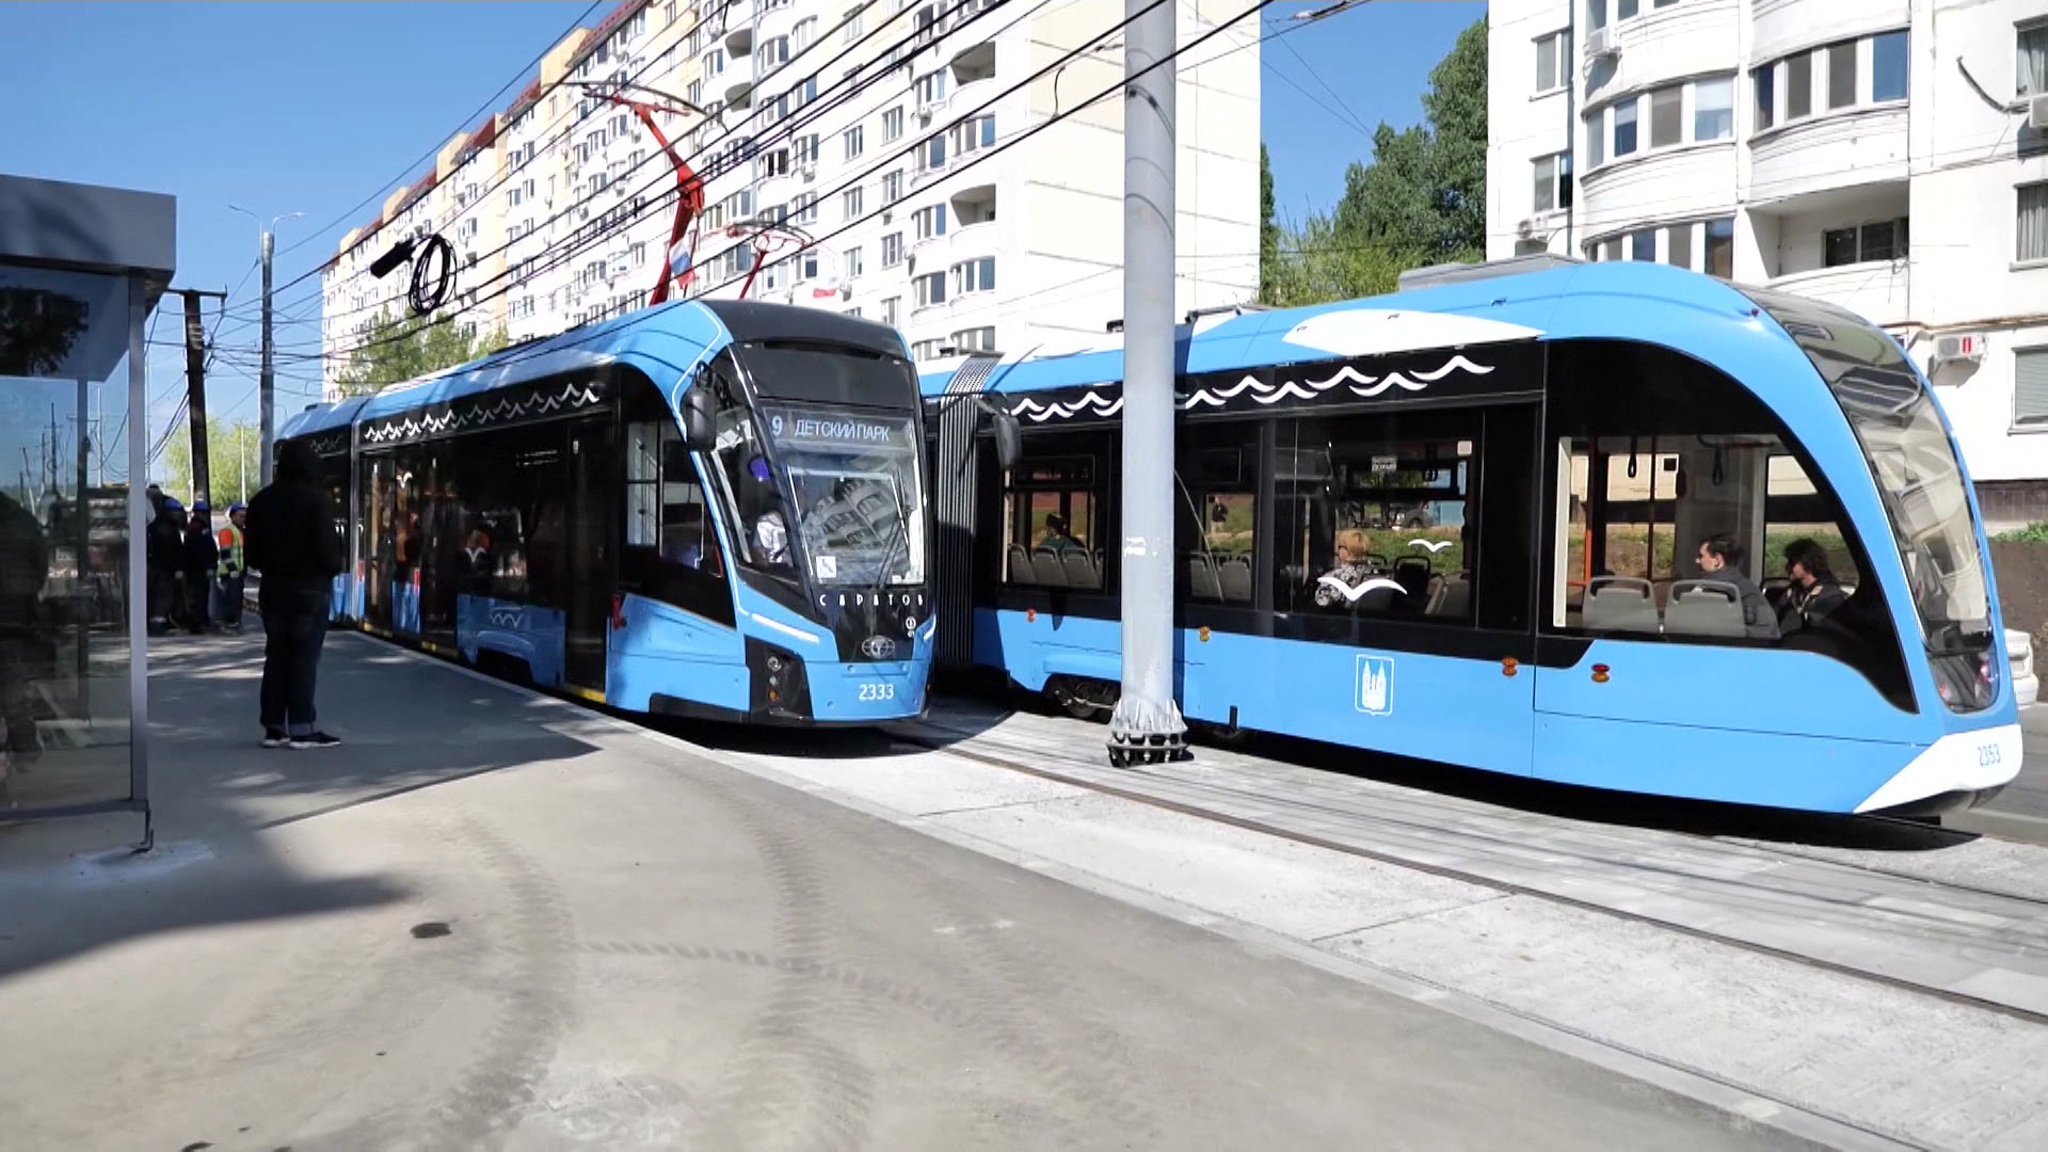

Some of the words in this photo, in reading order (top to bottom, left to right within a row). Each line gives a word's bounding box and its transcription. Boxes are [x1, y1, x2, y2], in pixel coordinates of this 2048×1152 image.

[772, 415, 783, 436] 9
[794, 419, 856, 439] ДЕТСКИЙ
[857, 424, 890, 442] ПАРК
[858, 683, 895, 701] 2333
[1977, 743, 2001, 768] 2353
